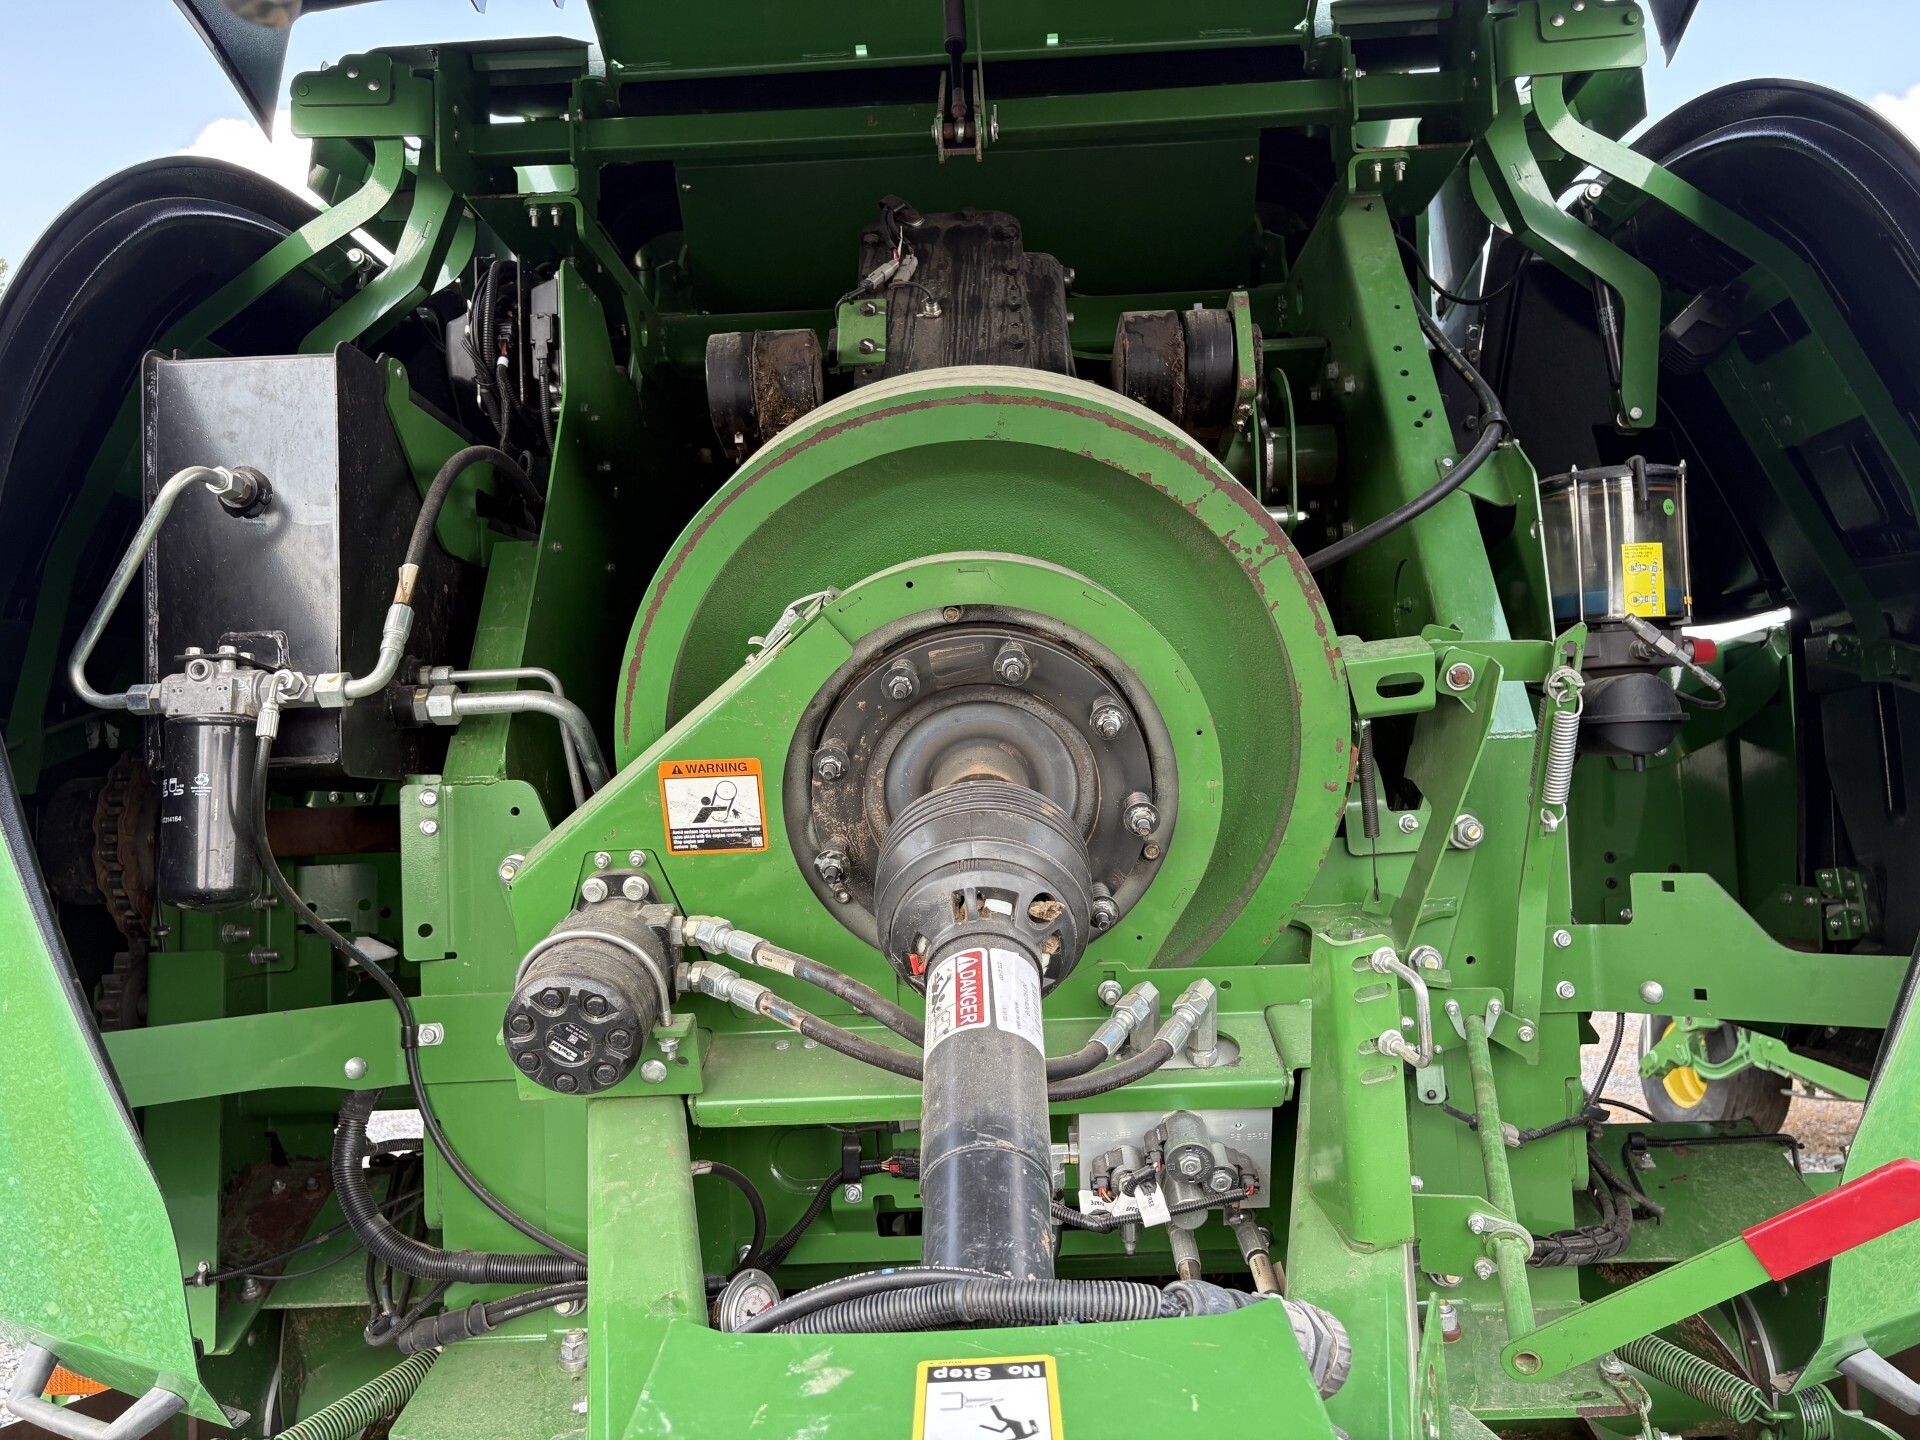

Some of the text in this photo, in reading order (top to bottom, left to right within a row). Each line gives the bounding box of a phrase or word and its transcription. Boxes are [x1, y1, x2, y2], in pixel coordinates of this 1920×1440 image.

[685, 762, 748, 774] WARNING
[960, 971, 978, 1026] DANGER
[551, 1042, 572, 1056] Parker
[1230, 1132, 1269, 1141] REERSE
[933, 1364, 1041, 1380] No Step
